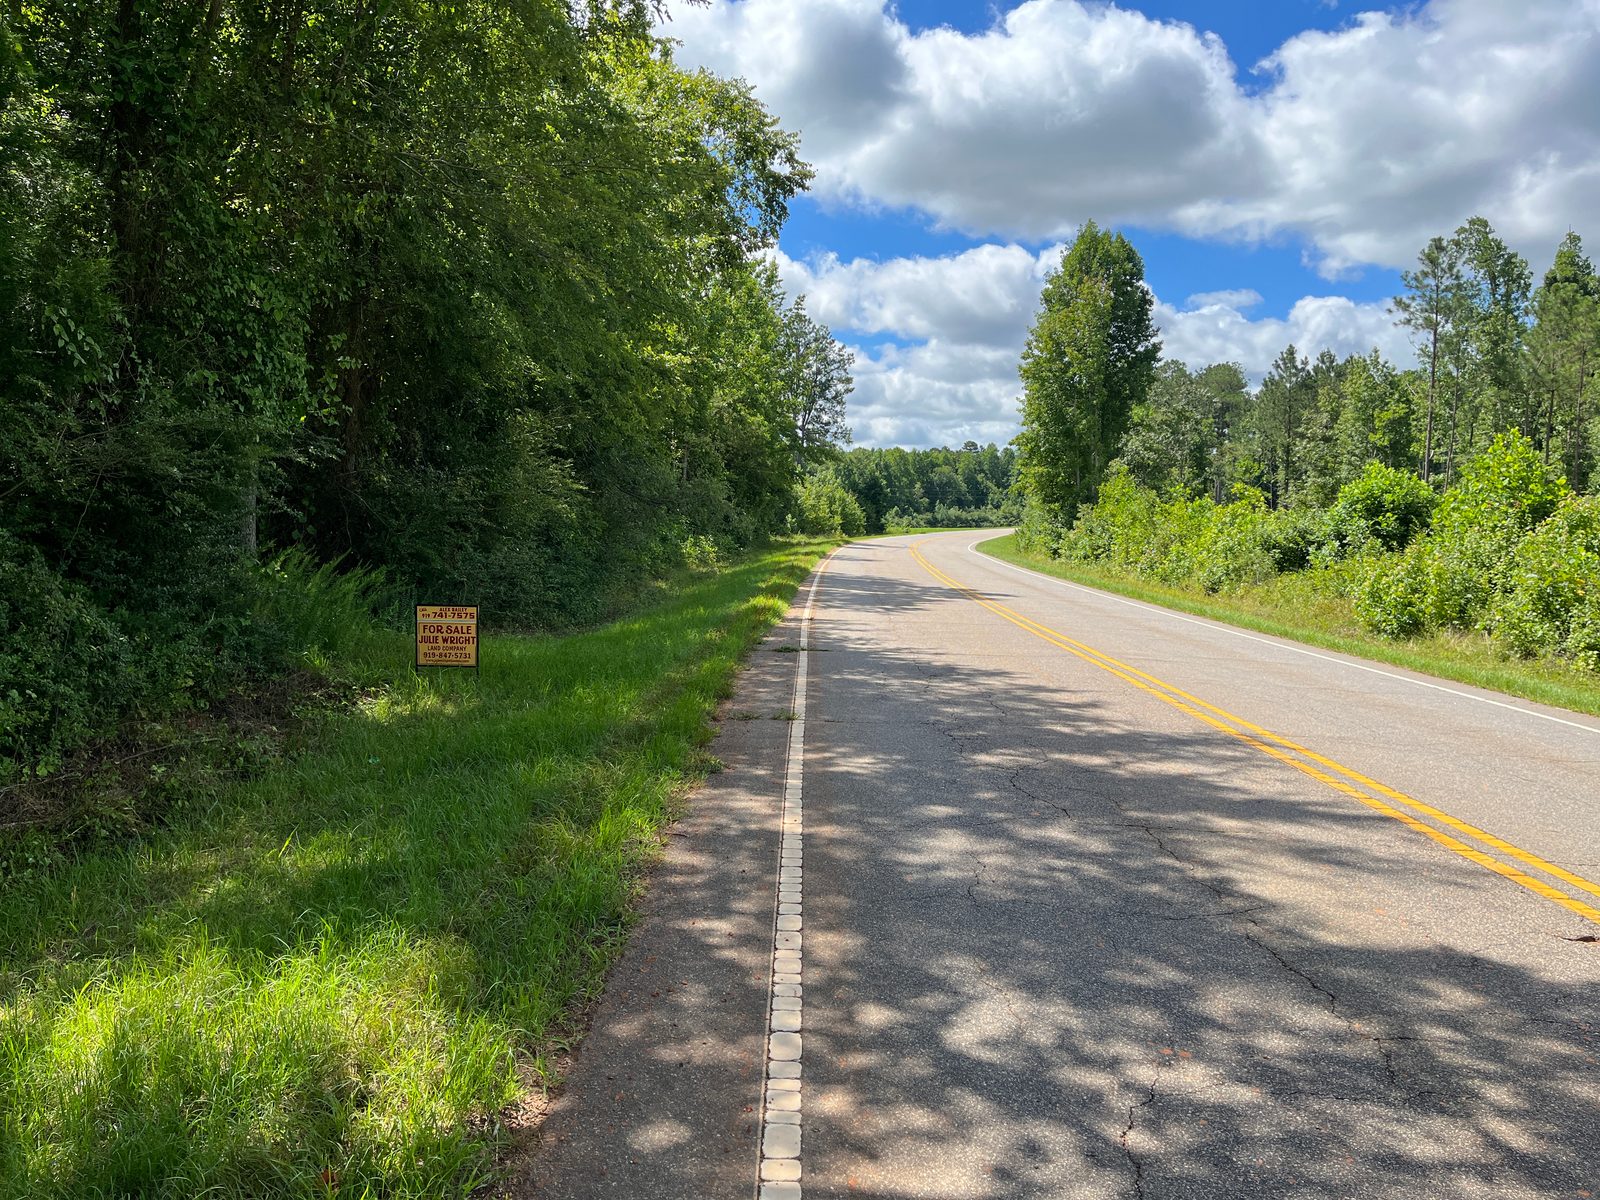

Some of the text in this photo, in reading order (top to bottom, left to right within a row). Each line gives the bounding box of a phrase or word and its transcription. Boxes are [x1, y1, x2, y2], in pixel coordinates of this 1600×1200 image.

[423, 625, 472, 634] FOR SALE
[419, 635, 476, 644] JULIE WRIGHT
